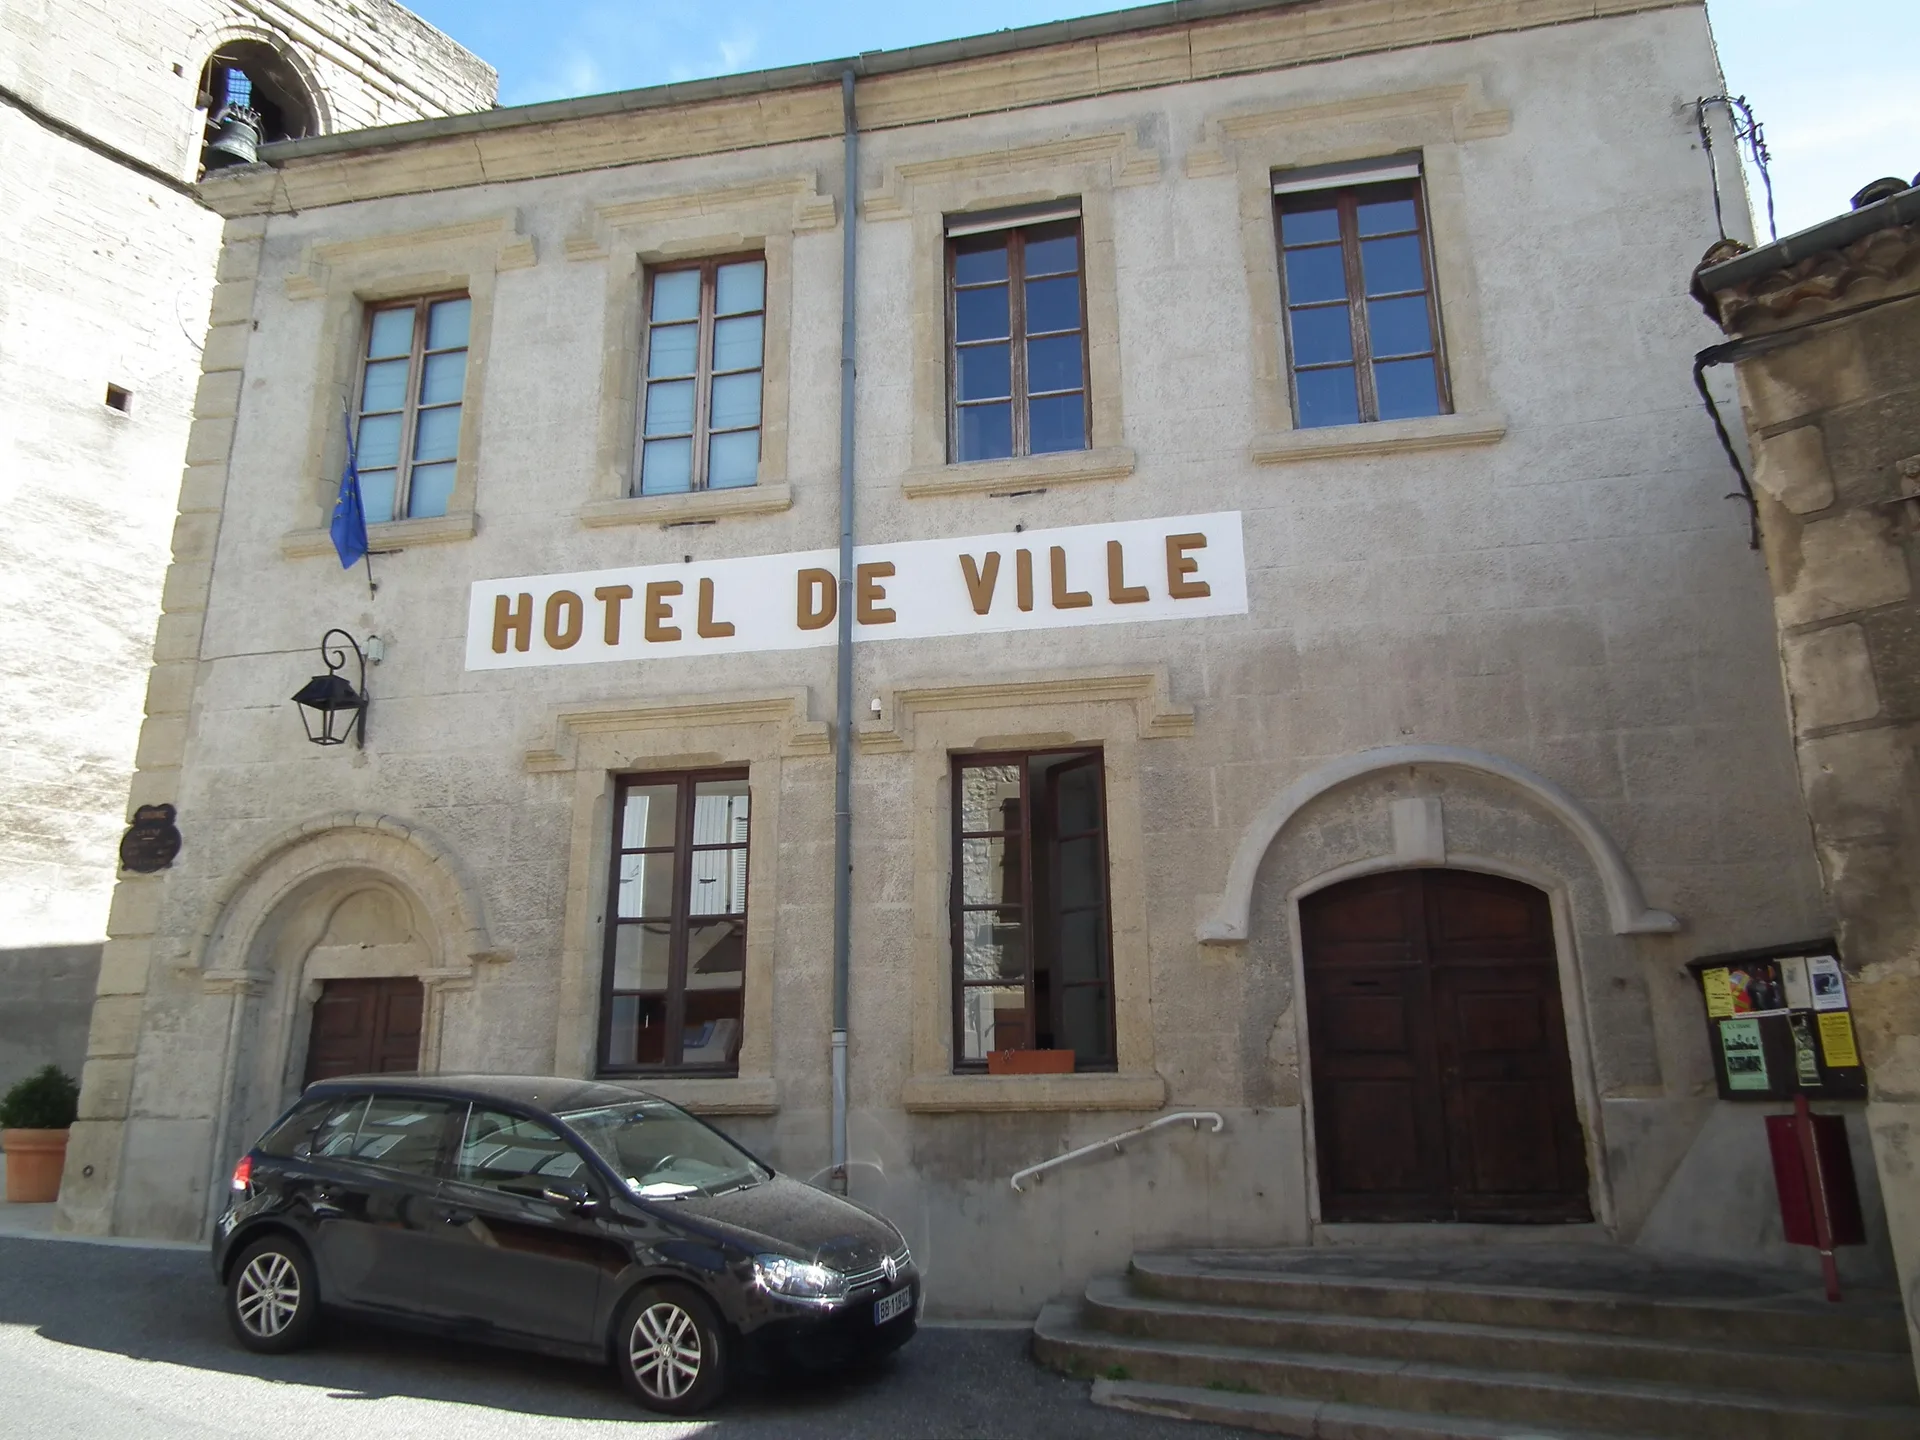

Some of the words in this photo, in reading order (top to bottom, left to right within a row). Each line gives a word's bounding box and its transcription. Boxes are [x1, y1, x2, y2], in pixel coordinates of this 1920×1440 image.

[492, 578, 735, 654] HOTEL
[797, 561, 897, 631] DE
[959, 533, 1211, 616] VILLE
